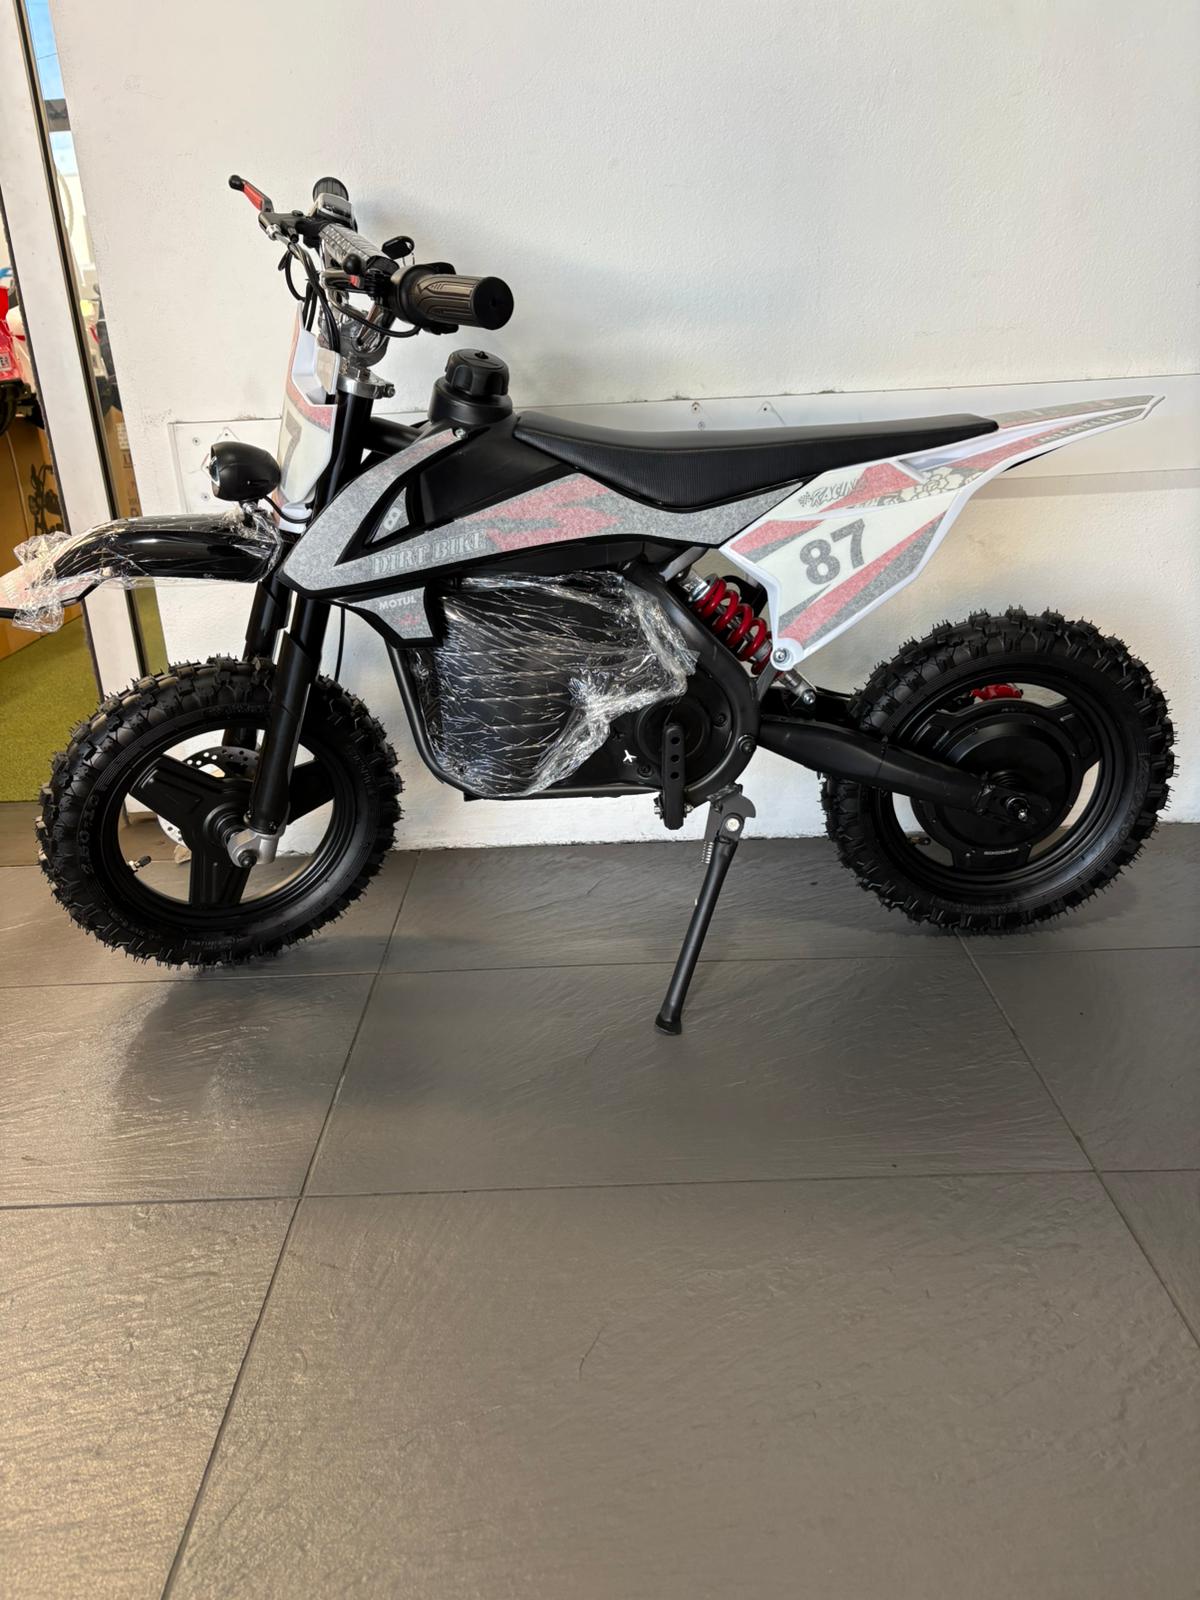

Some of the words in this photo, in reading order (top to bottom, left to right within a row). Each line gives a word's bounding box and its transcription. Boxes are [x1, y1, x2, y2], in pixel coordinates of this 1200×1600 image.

[371, 544, 430, 576] DIRT
[432, 527, 488, 561] BIKE
[800, 518, 865, 585] 87
[379, 594, 418, 611] MOTUL
